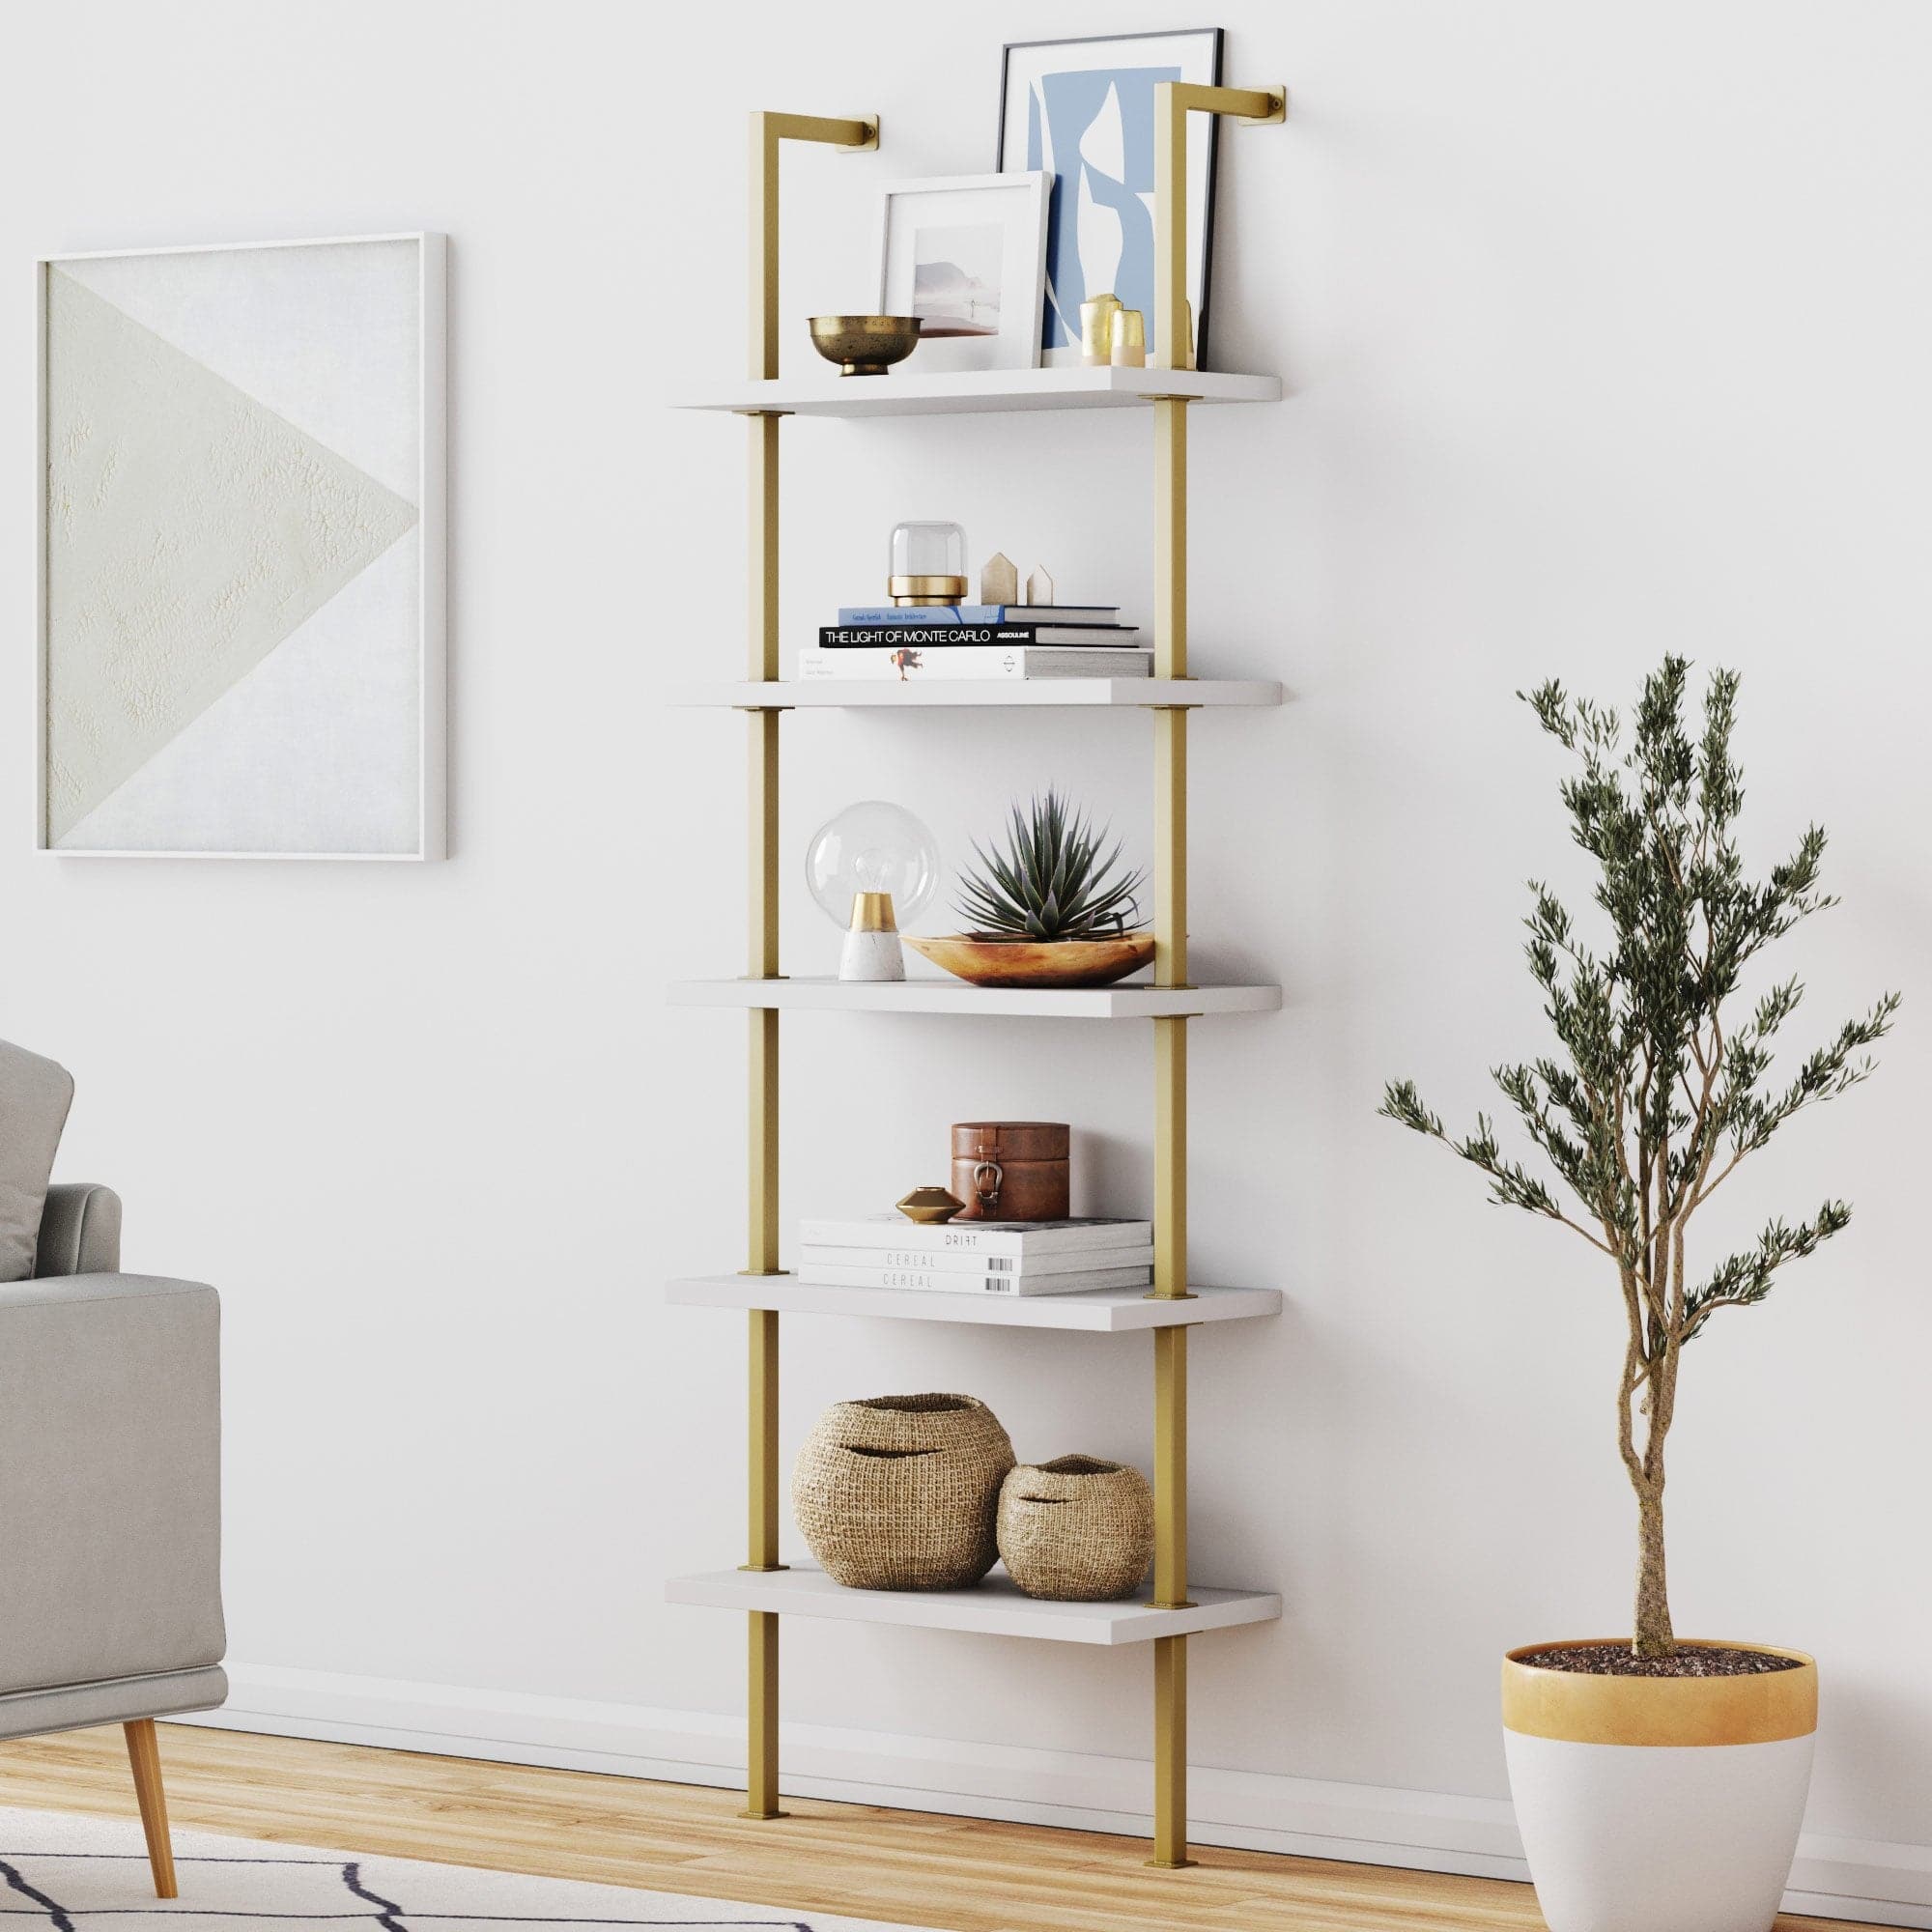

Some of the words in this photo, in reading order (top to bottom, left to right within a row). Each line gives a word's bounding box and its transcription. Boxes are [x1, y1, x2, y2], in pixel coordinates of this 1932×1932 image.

[825, 631, 849, 643] THE
[850, 631, 885, 643] LIGHT
[885, 630, 902, 643] OF
[903, 630, 948, 642] MONTE
[949, 629, 991, 642] CARLO
[996, 631, 1030, 639] ASSOULINE
[945, 1234, 978, 1247] DRIFT
[887, 1253, 935, 1267] CEREAL
[883, 1273, 932, 1288] CEREAL
